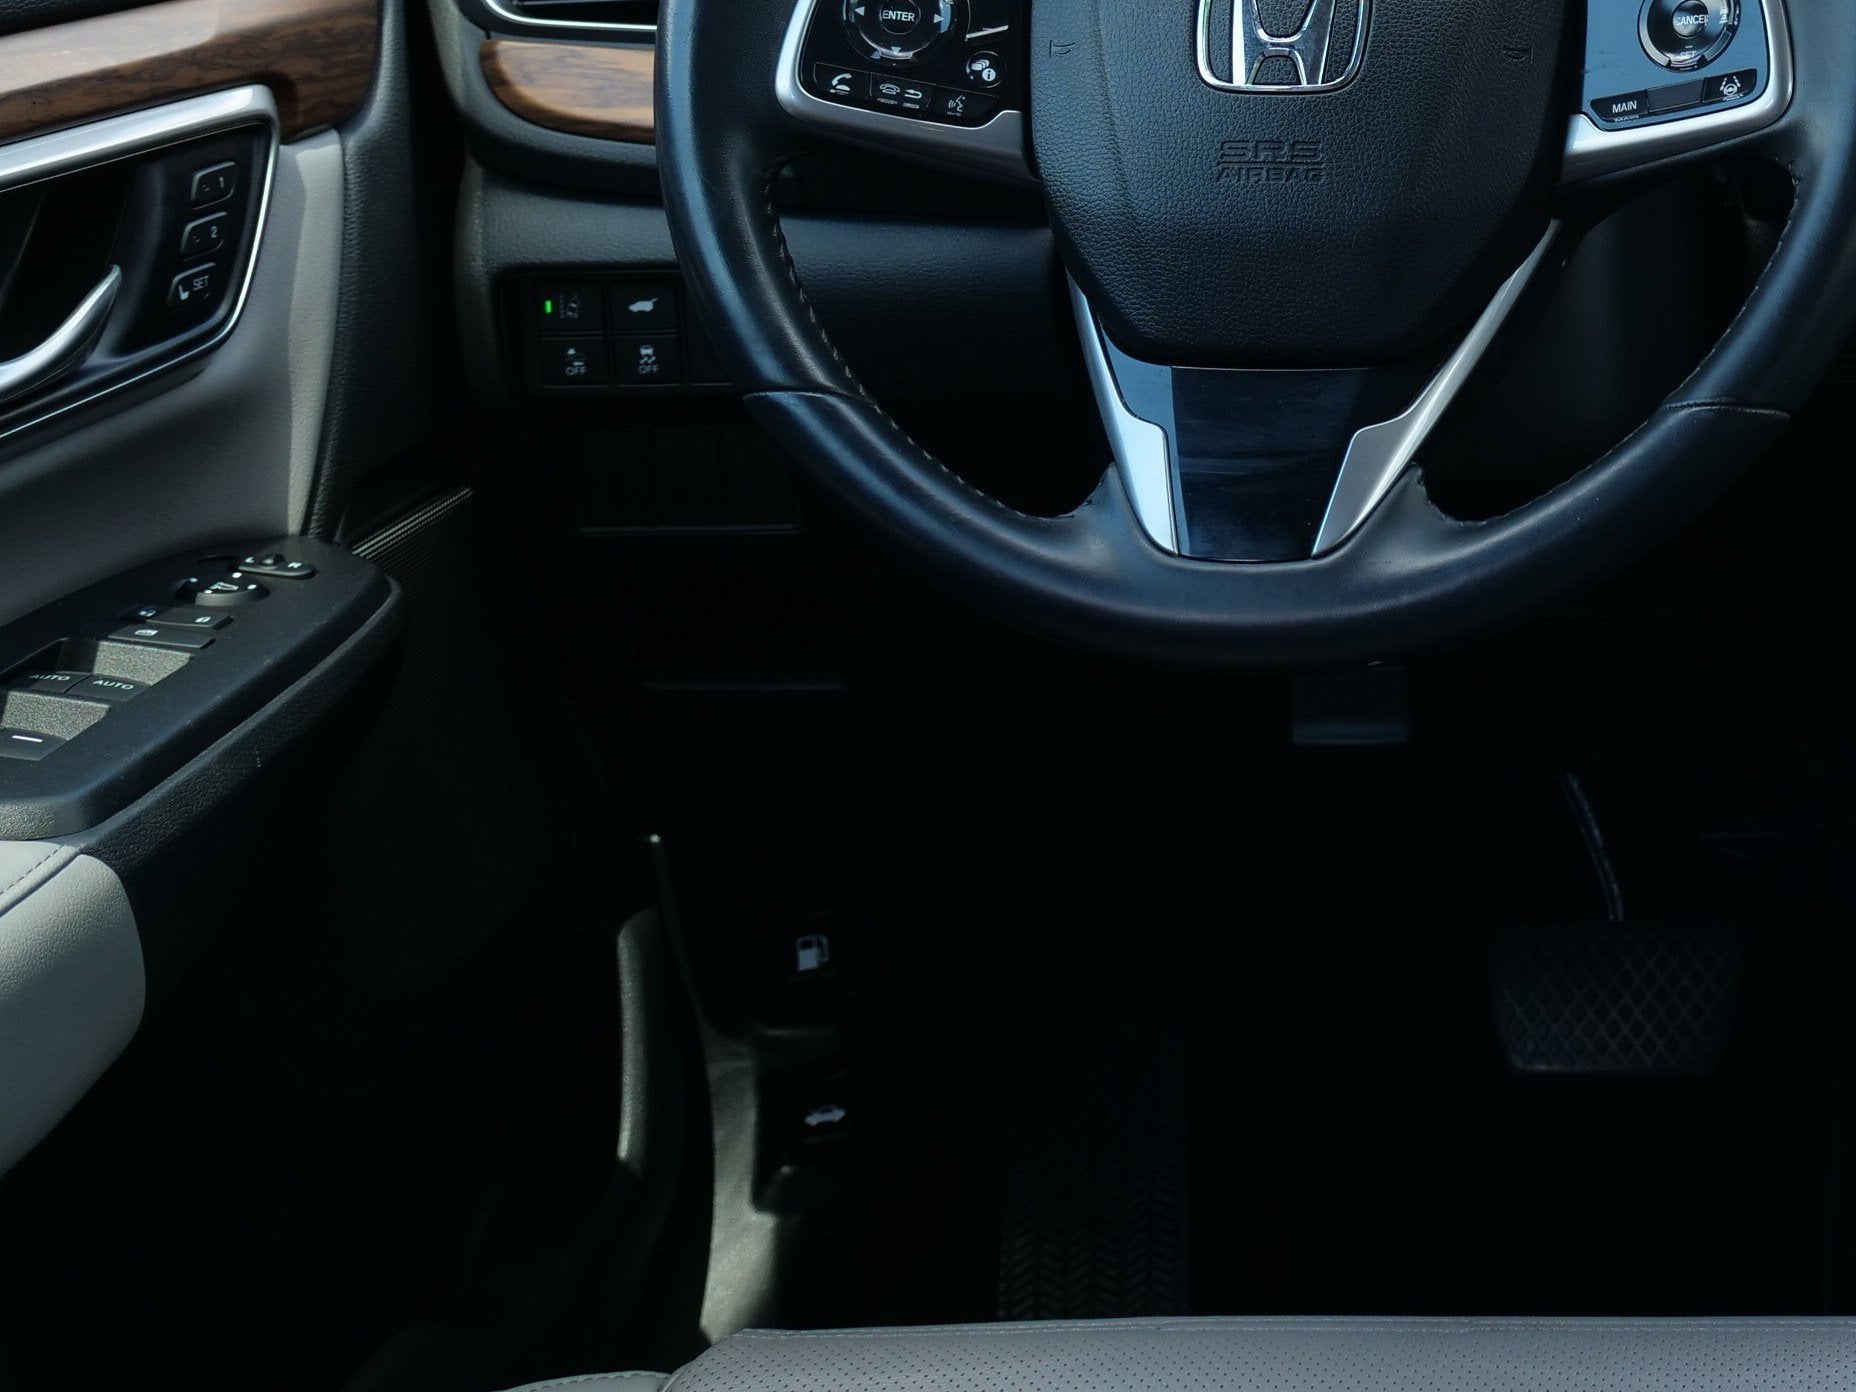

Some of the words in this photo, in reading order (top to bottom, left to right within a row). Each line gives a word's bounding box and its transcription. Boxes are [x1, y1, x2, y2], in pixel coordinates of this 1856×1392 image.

[882, 10, 915, 23] ENTER
[1612, 100, 1637, 114] MAIN
[1220, 140, 1322, 163] SRS
[1217, 167, 1325, 184] AIRBAG
[219, 176, 225, 188] 1
[210, 226, 218, 238] 2
[565, 366, 588, 376] OFF
[637, 365, 659, 375] OFF
[28, 672, 71, 682] AUTO
[92, 678, 134, 691] AUTO
